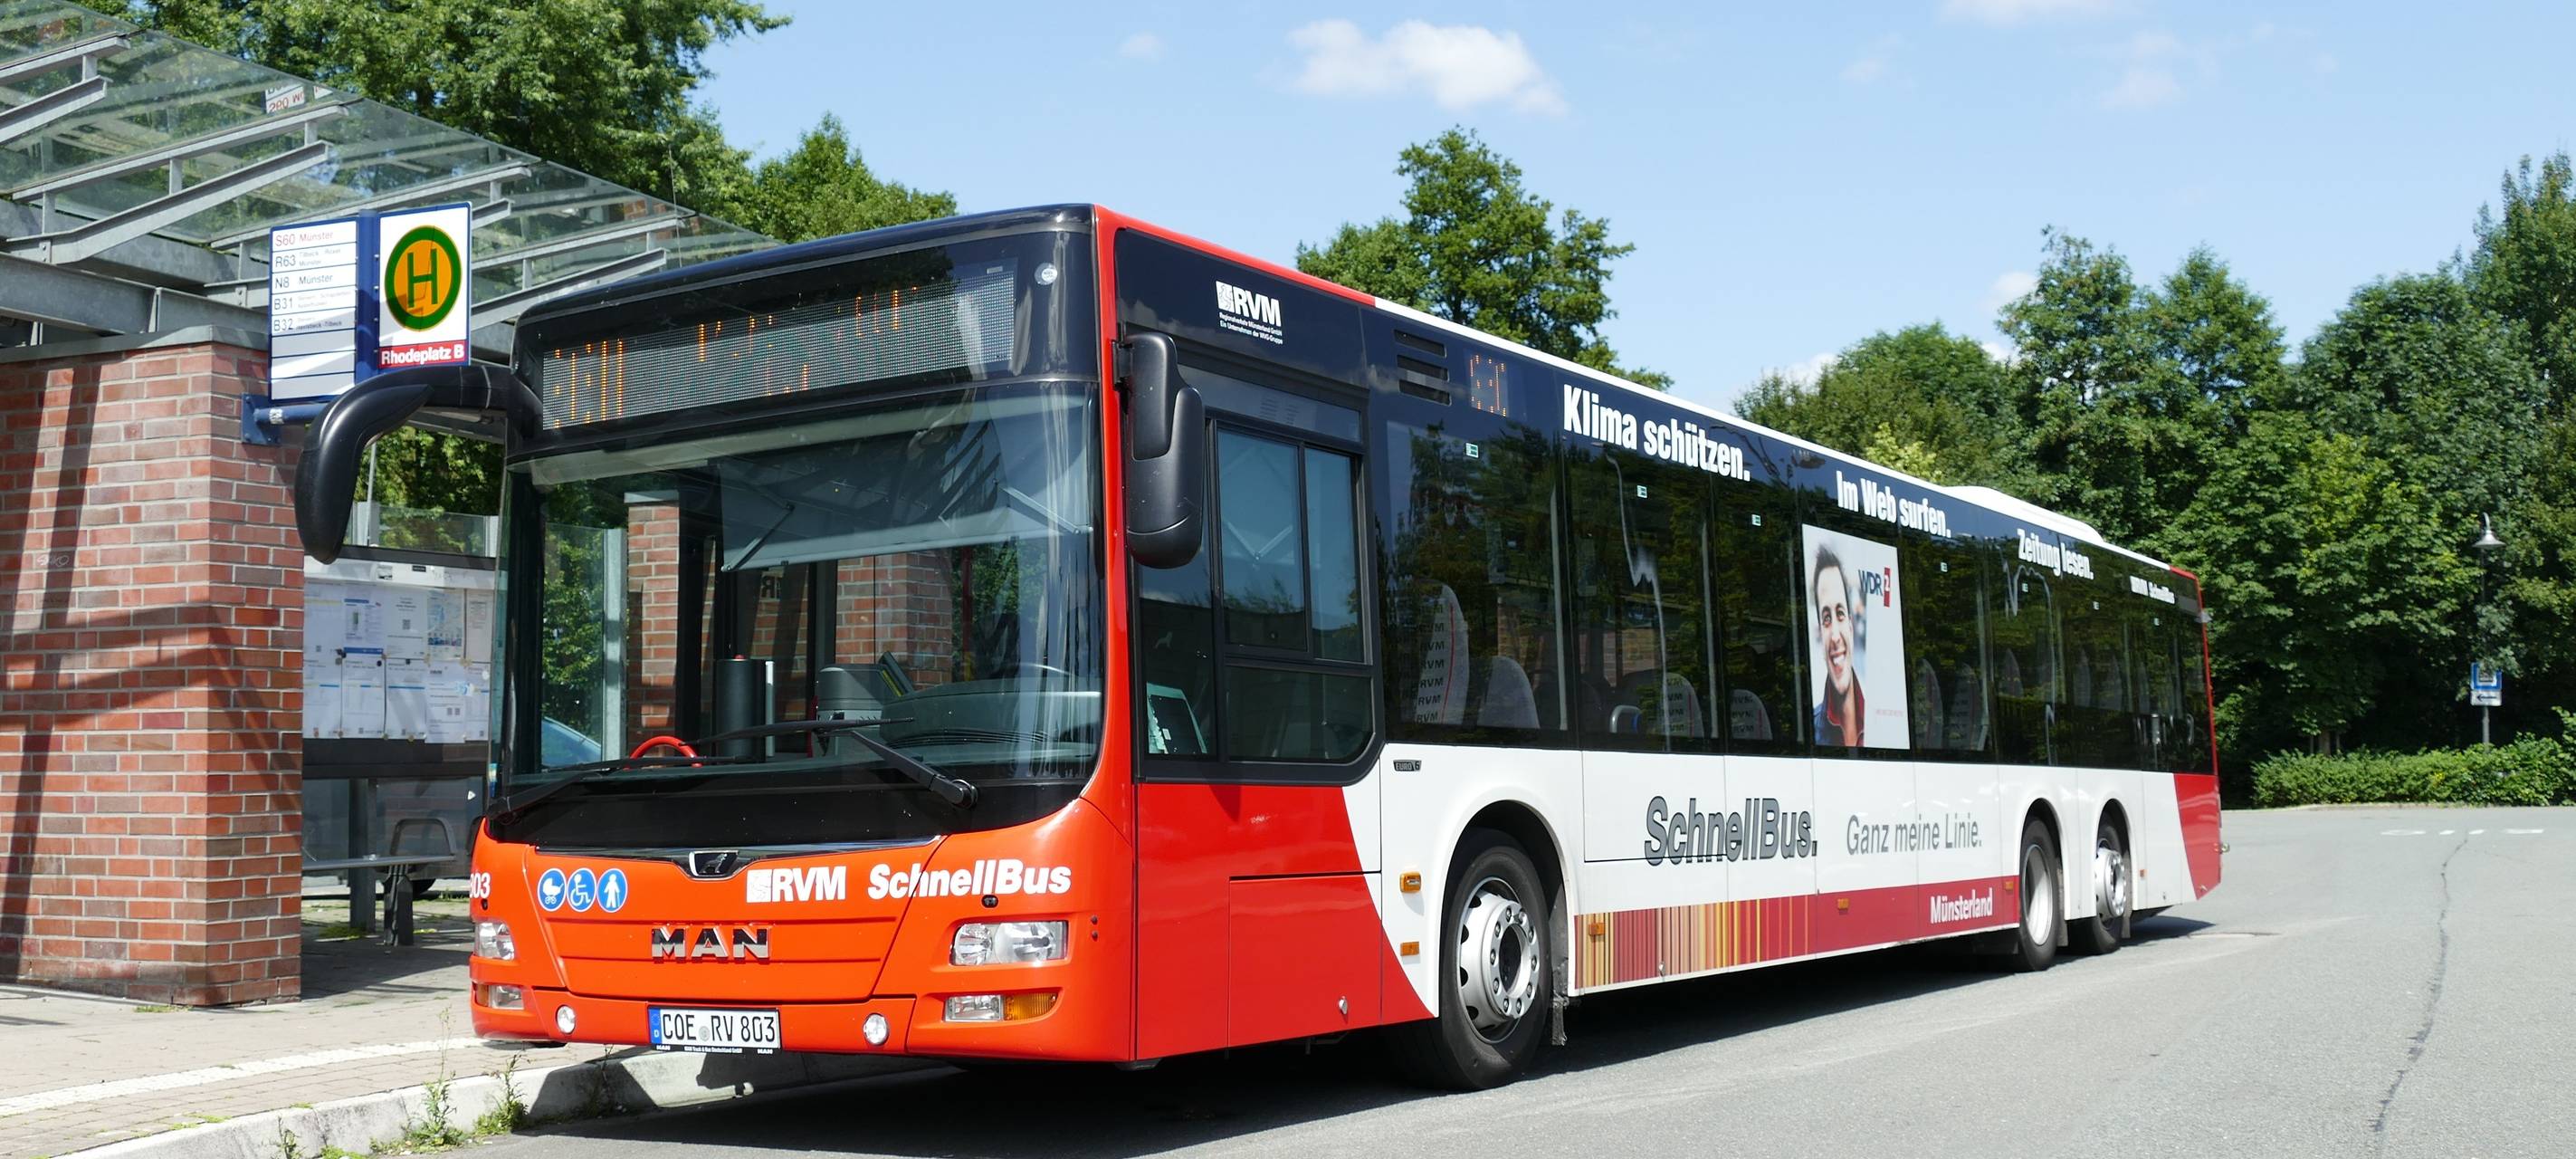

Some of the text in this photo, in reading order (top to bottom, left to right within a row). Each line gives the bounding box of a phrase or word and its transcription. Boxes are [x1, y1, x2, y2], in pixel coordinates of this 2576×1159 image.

[275, 231, 334, 247] S60 Münster
[275, 254, 297, 267] R63
[275, 274, 333, 289] N8 Münster
[406, 248, 438, 309] H
[274, 297, 293, 311] B31
[1233, 286, 1282, 327] RVM
[273, 318, 294, 331] B32
[381, 344, 464, 365] Rhodeplatz B
[1563, 384, 1637, 450] Klima
[1644, 418, 1751, 482] schützen.
[1836, 471, 1951, 538] Im Web surfen.
[2017, 528, 2094, 580] Zeitung lesen.
[1858, 570, 1891, 598] WDR 2
[1419, 677, 1444, 688] RVM
[1417, 694, 1441, 706] RVM
[1415, 761, 1420, 771] 6
[1644, 796, 1818, 867] SchnellBus.
[1846, 813, 1982, 856] Ganz meine Linie.
[772, 858, 1072, 903] RVM SchnellBus
[1930, 888, 1993, 924] Münsterland
[652, 928, 769, 960] MAN
[663, 1013, 697, 1040] COE
[711, 1015, 733, 1041] RV
[740, 1016, 776, 1042] 803
